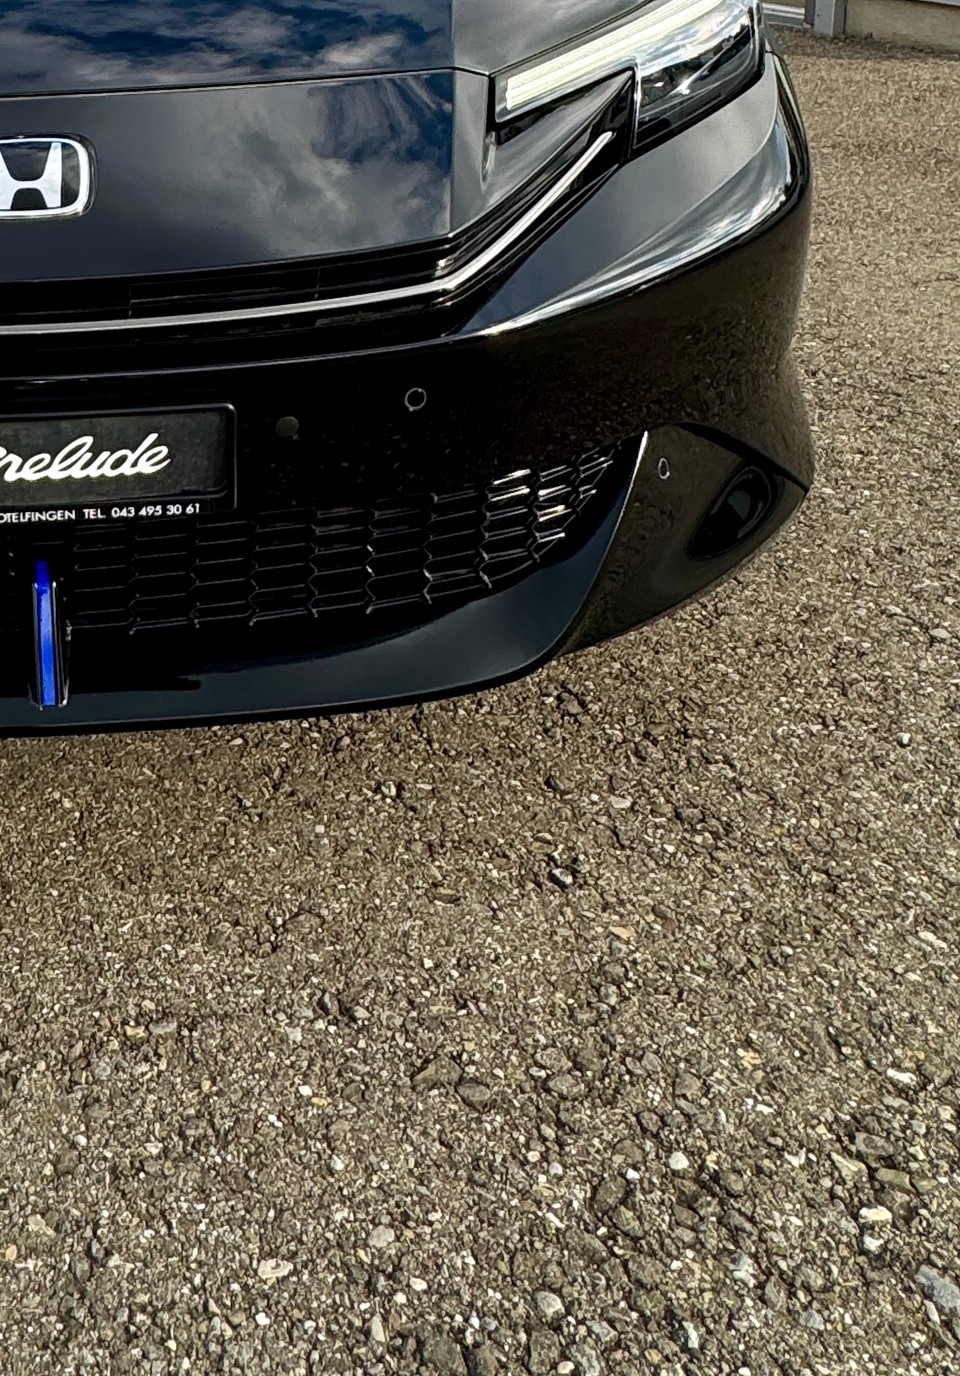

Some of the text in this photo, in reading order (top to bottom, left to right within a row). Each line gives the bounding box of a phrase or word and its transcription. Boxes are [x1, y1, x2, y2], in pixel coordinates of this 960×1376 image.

[111, 506, 135, 519] 043
[138, 505, 163, 517] 495
[166, 503, 183, 515] 30
[185, 502, 201, 515] 61
